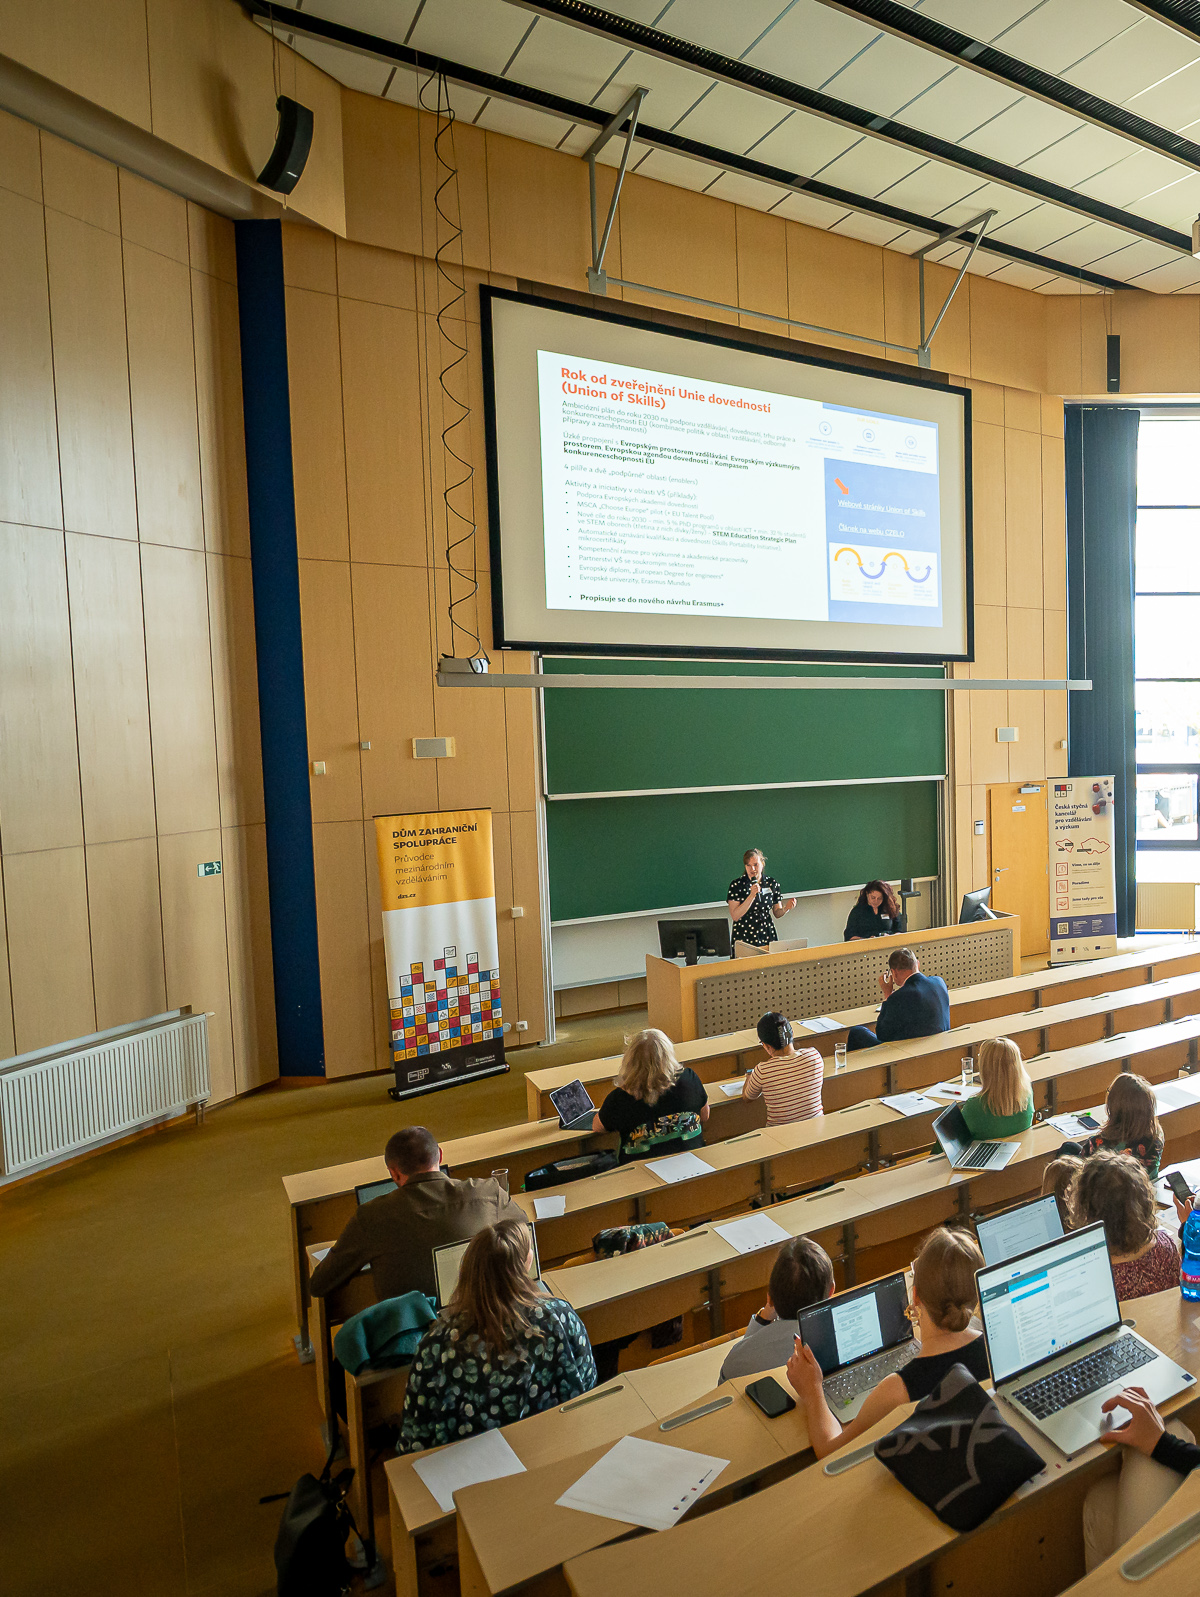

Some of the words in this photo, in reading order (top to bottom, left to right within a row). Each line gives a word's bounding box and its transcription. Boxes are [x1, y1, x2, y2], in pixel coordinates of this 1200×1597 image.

[561, 368, 587, 382] Rok
[591, 374, 607, 385] od
[611, 379, 675, 396] zveřejnění
[679, 388, 705, 402] Unie
[708, 394, 770, 413] dovedností
[562, 381, 607, 399] (Union
[611, 391, 624, 402] of
[628, 393, 666, 410] Skills)
[564, 440, 603, 451] prostorem,
[605, 445, 642, 456] Evropskou
[643, 450, 672, 460] agendou
[673, 455, 709, 464] dovedností
[715, 460, 748, 470] Kompasem
[564, 447, 644, 463] konkurenceschopnosti
[620, 440, 658, 451] Evropským
[660, 447, 694, 456] prostorem
[695, 452, 729, 461] vzdělávání,
[731, 455, 764, 465] Evropským
[765, 460, 800, 470] výzkumným
[580, 594, 616, 603] Propisuje
[666, 598, 691, 606] návrhu
[392, 828, 417, 838] DŮM
[419, 823, 477, 836] ZAHRANIČNÍ
[393, 836, 457, 849] SPOLUPRÁCE
[394, 853, 434, 863] Průvodce
[396, 862, 454, 874] mezinárodním
[396, 874, 448, 885] vzděláváním
